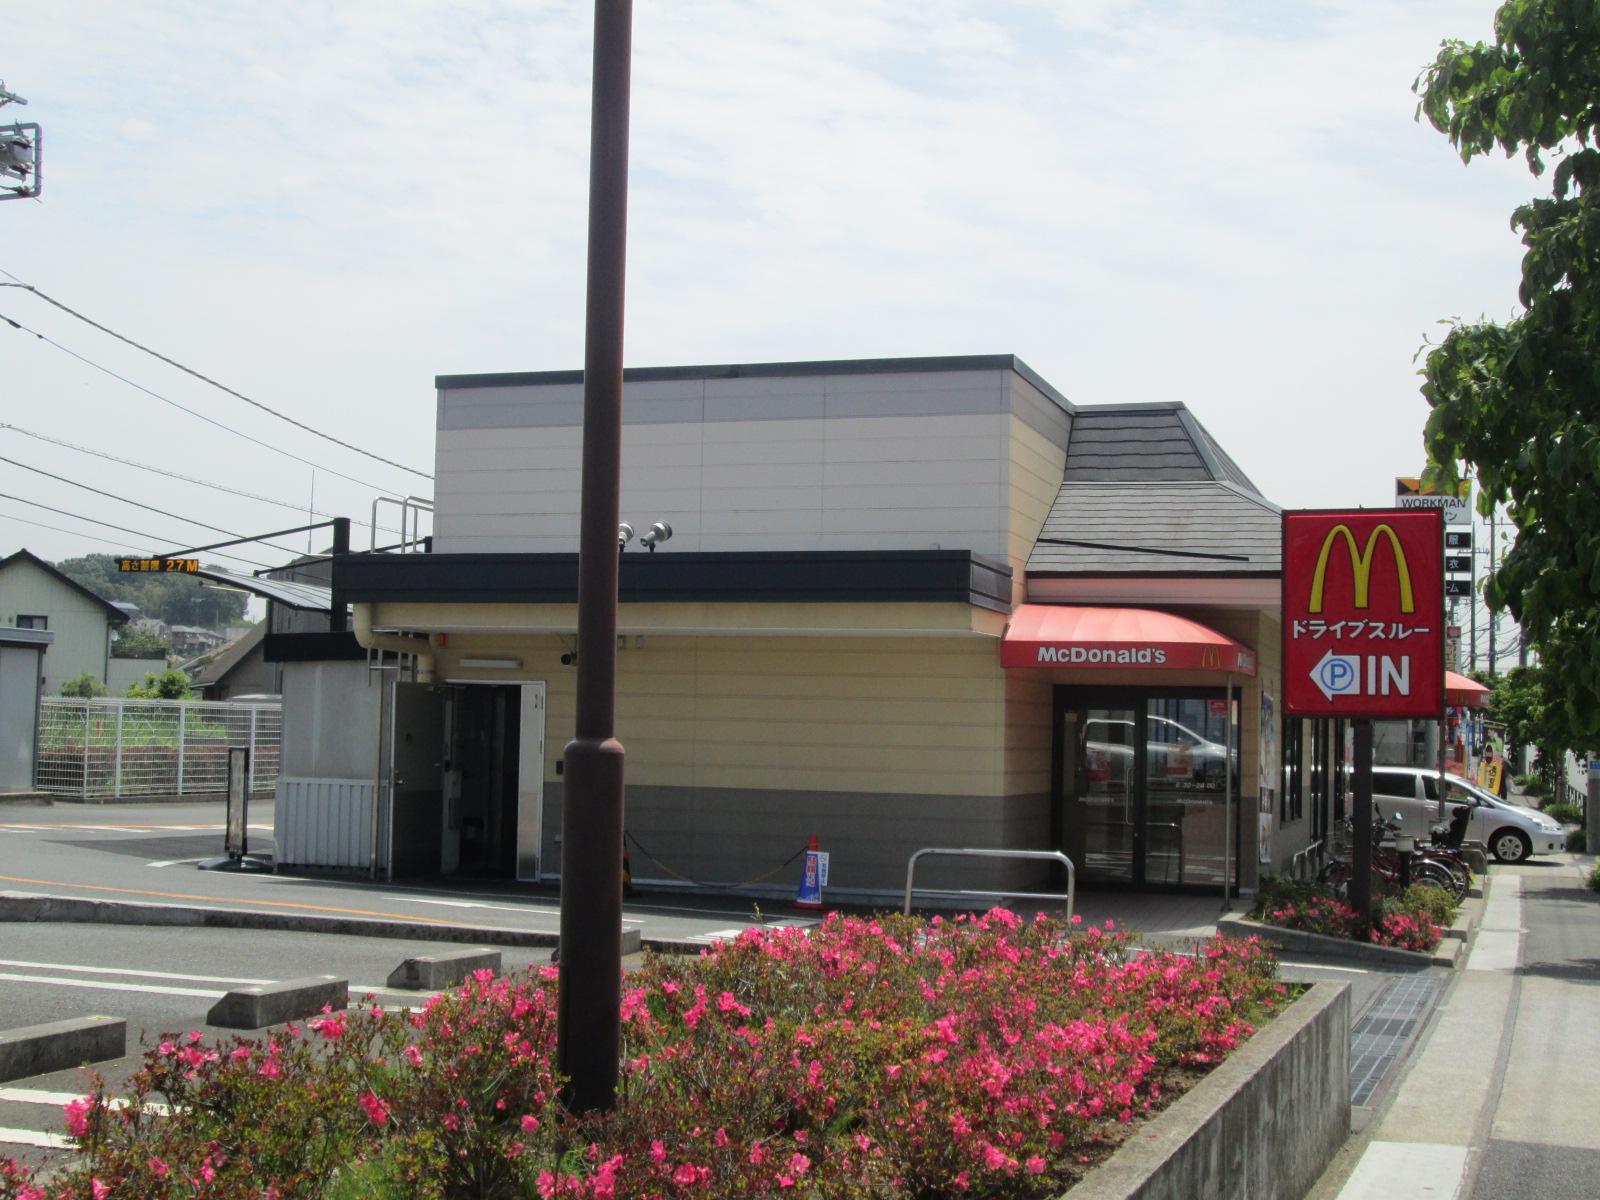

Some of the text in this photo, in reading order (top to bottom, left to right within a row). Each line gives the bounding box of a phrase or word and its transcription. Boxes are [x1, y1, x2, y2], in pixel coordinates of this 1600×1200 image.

[1401, 498, 1466, 508] WORKMAN
[121, 560, 160, 571] 高さ制限
[1293, 618, 1429, 639] ドライブスルー
[1037, 646, 1166, 663] McDonald's
[1367, 655, 1410, 696] IN
